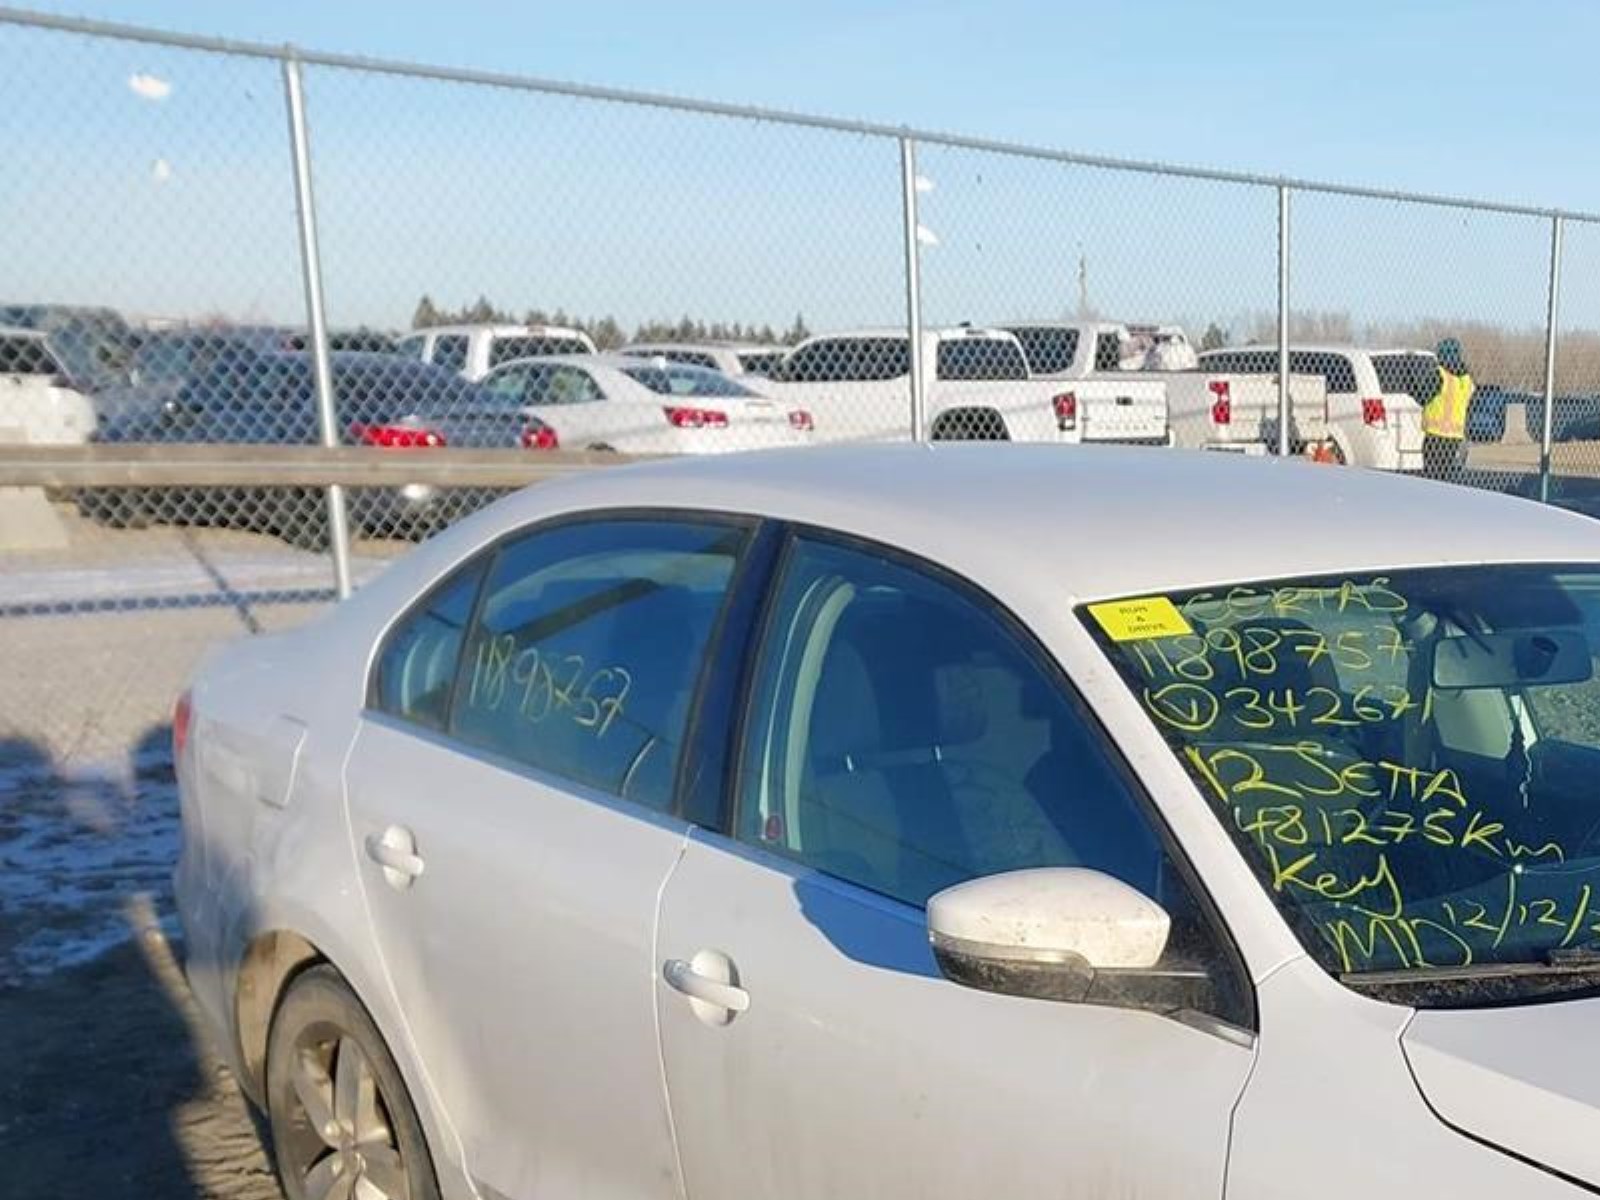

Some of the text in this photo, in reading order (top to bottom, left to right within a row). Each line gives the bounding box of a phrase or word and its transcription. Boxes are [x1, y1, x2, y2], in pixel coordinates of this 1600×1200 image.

[1182, 577, 1409, 623] CERTAS
[1133, 626, 1416, 681] 11898757
[1225, 685, 1434, 728] 342671
[1184, 747, 1305, 801] 12
